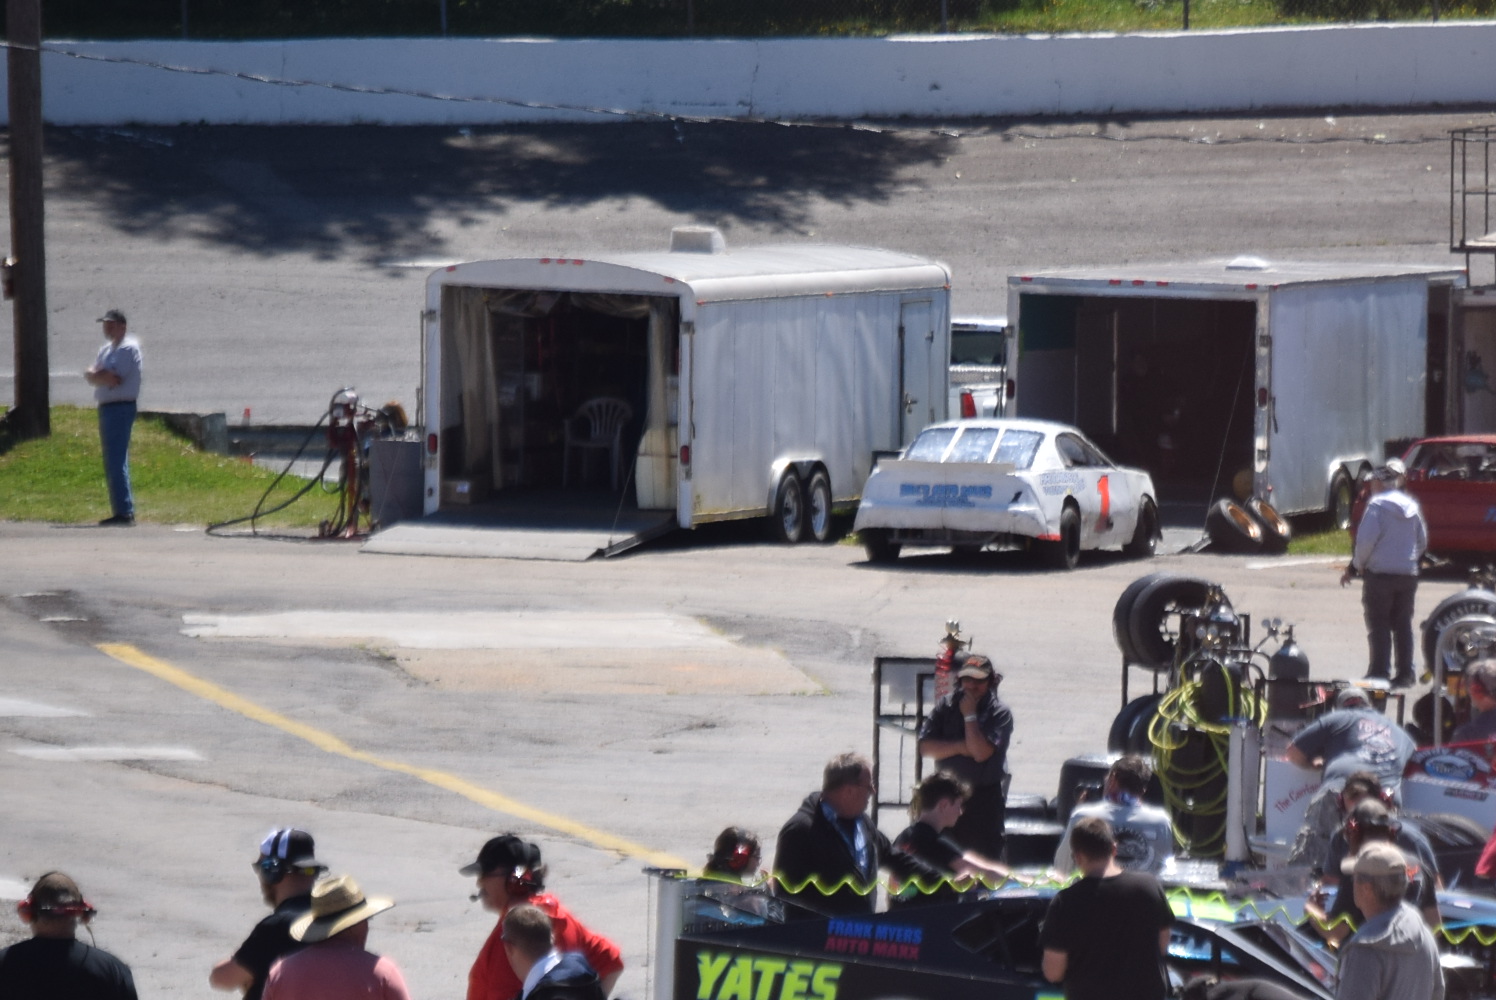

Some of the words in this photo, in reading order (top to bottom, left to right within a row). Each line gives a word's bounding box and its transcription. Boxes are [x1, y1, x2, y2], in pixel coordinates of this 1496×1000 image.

[828, 919, 873, 939] FRANK
[875, 924, 922, 945] MYERS
[824, 935, 869, 955] AUTO
